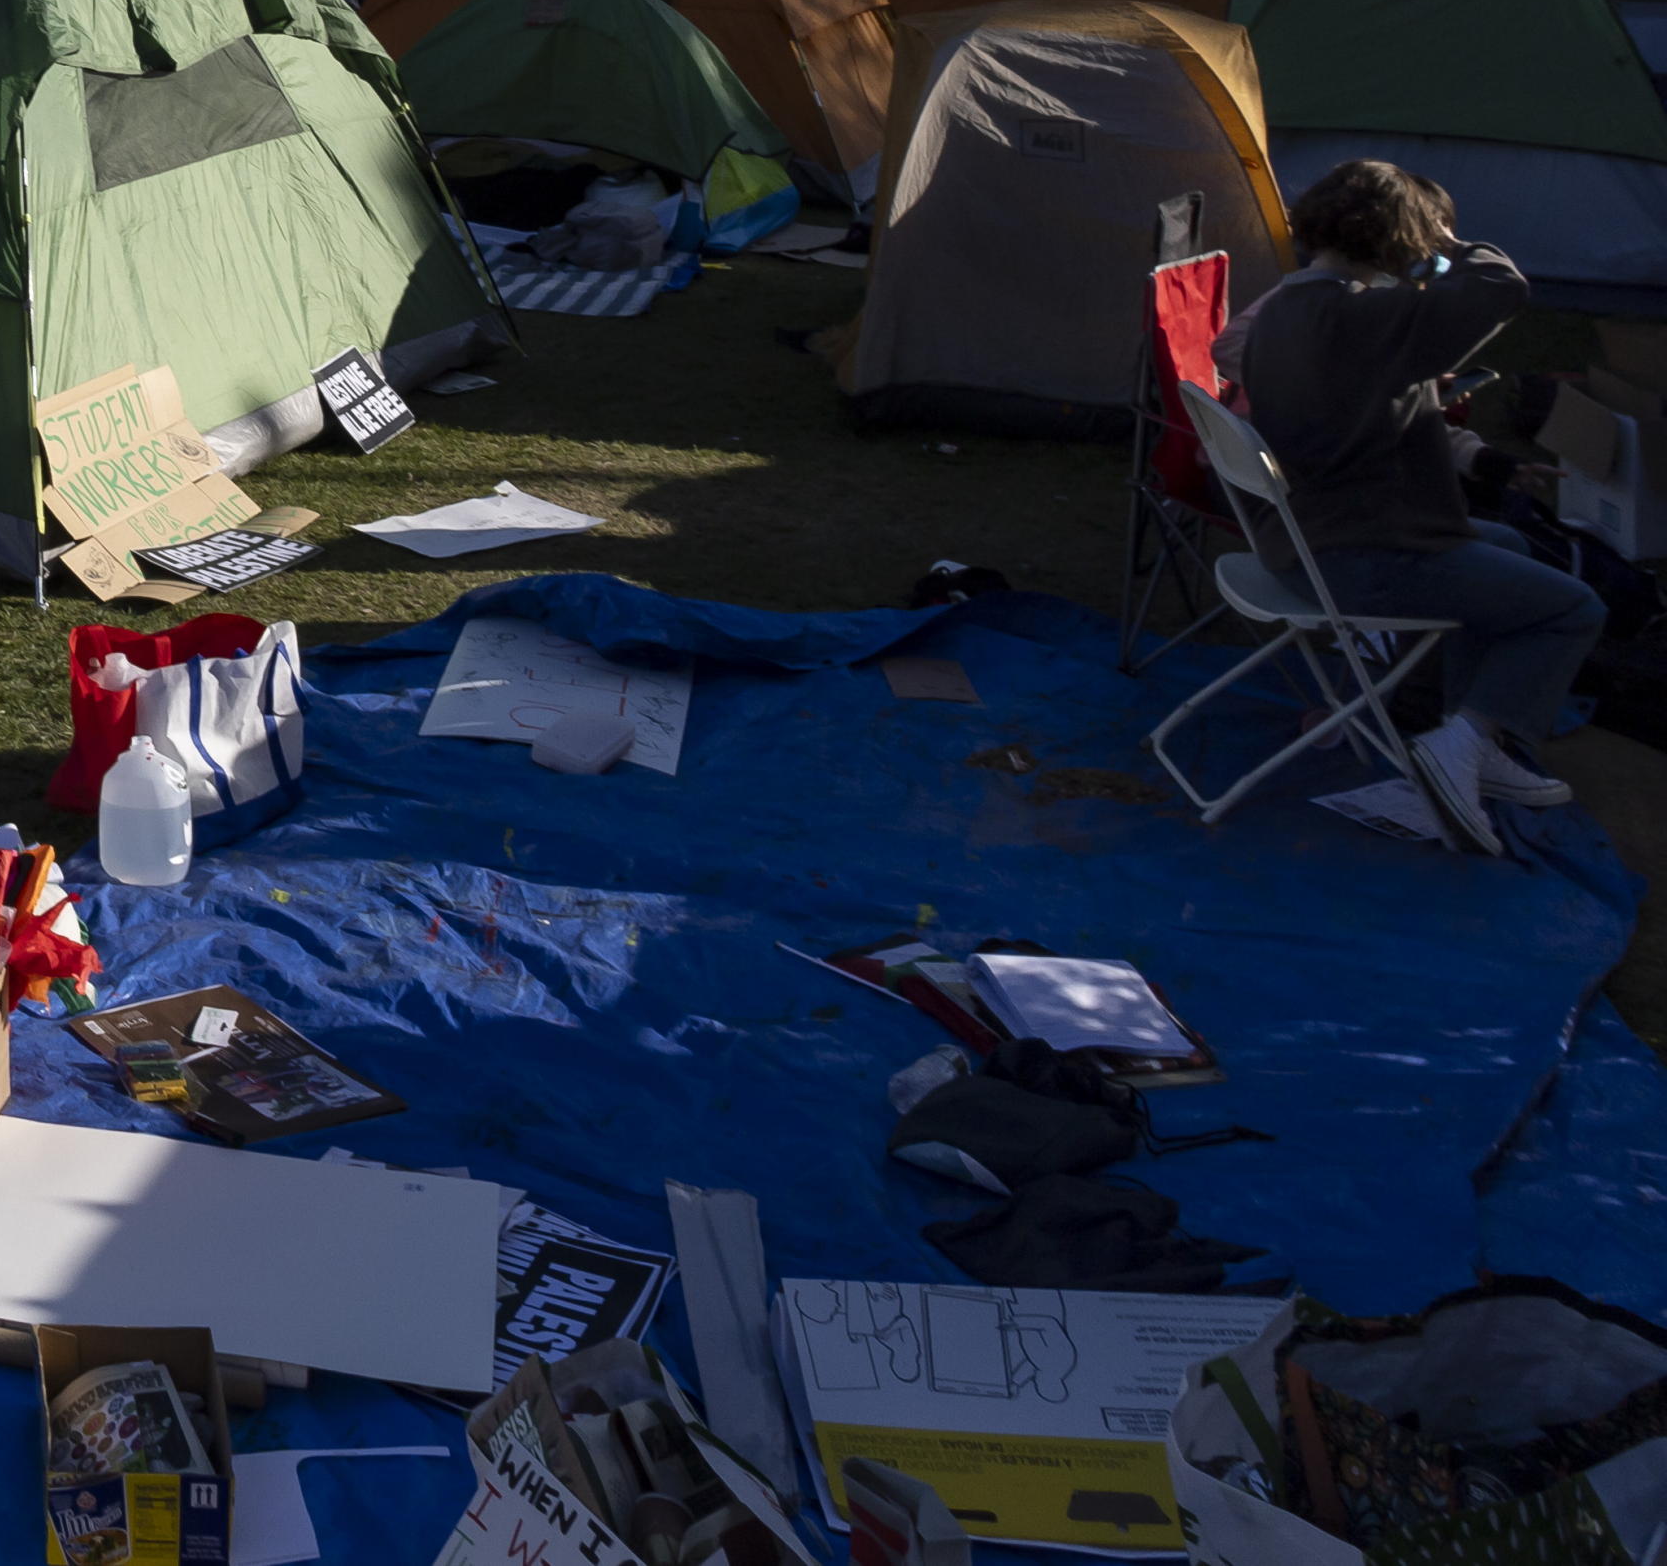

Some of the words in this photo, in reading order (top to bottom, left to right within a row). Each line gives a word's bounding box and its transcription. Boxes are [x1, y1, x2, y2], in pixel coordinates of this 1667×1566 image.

[42, 383, 151, 475] STUDENT
[363, 386, 408, 426] FREE
[60, 440, 185, 527] WORKERS
[126, 504, 182, 548] FOR
[147, 530, 264, 570] LIBERATE
[182, 538, 314, 589] PALESTINE
[497, 1444, 578, 1536] WHEN
[579, 1518, 614, 1564] I
